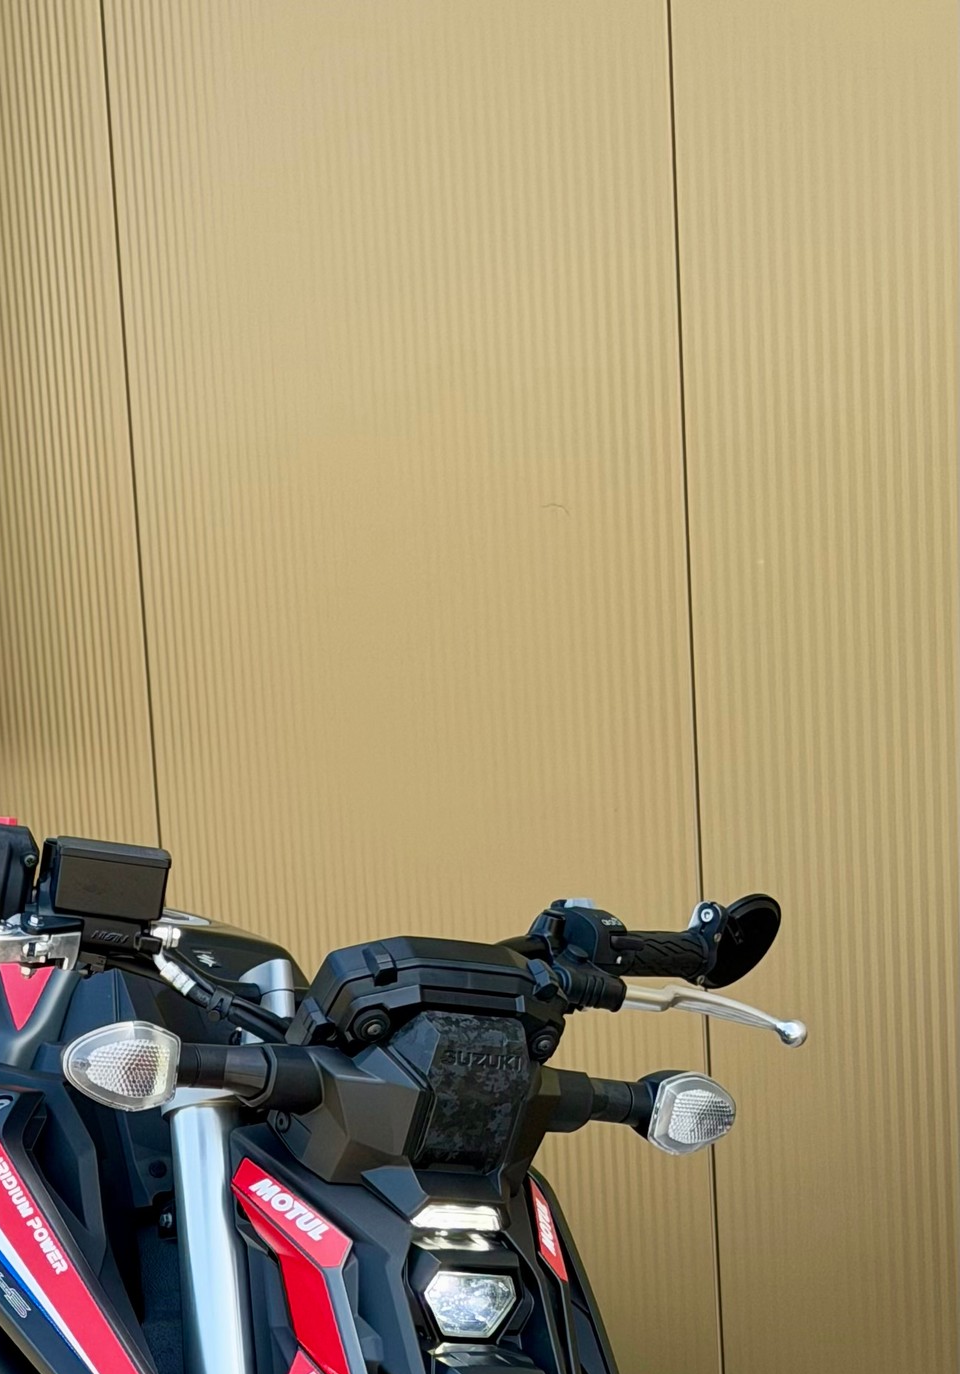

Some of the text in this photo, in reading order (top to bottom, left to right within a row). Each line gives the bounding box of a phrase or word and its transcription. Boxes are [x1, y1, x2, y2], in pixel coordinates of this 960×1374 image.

[441, 1048, 521, 1072] SUZUKI
[248, 1178, 330, 1242] MOTUL
[26, 1216, 69, 1275] POWER
